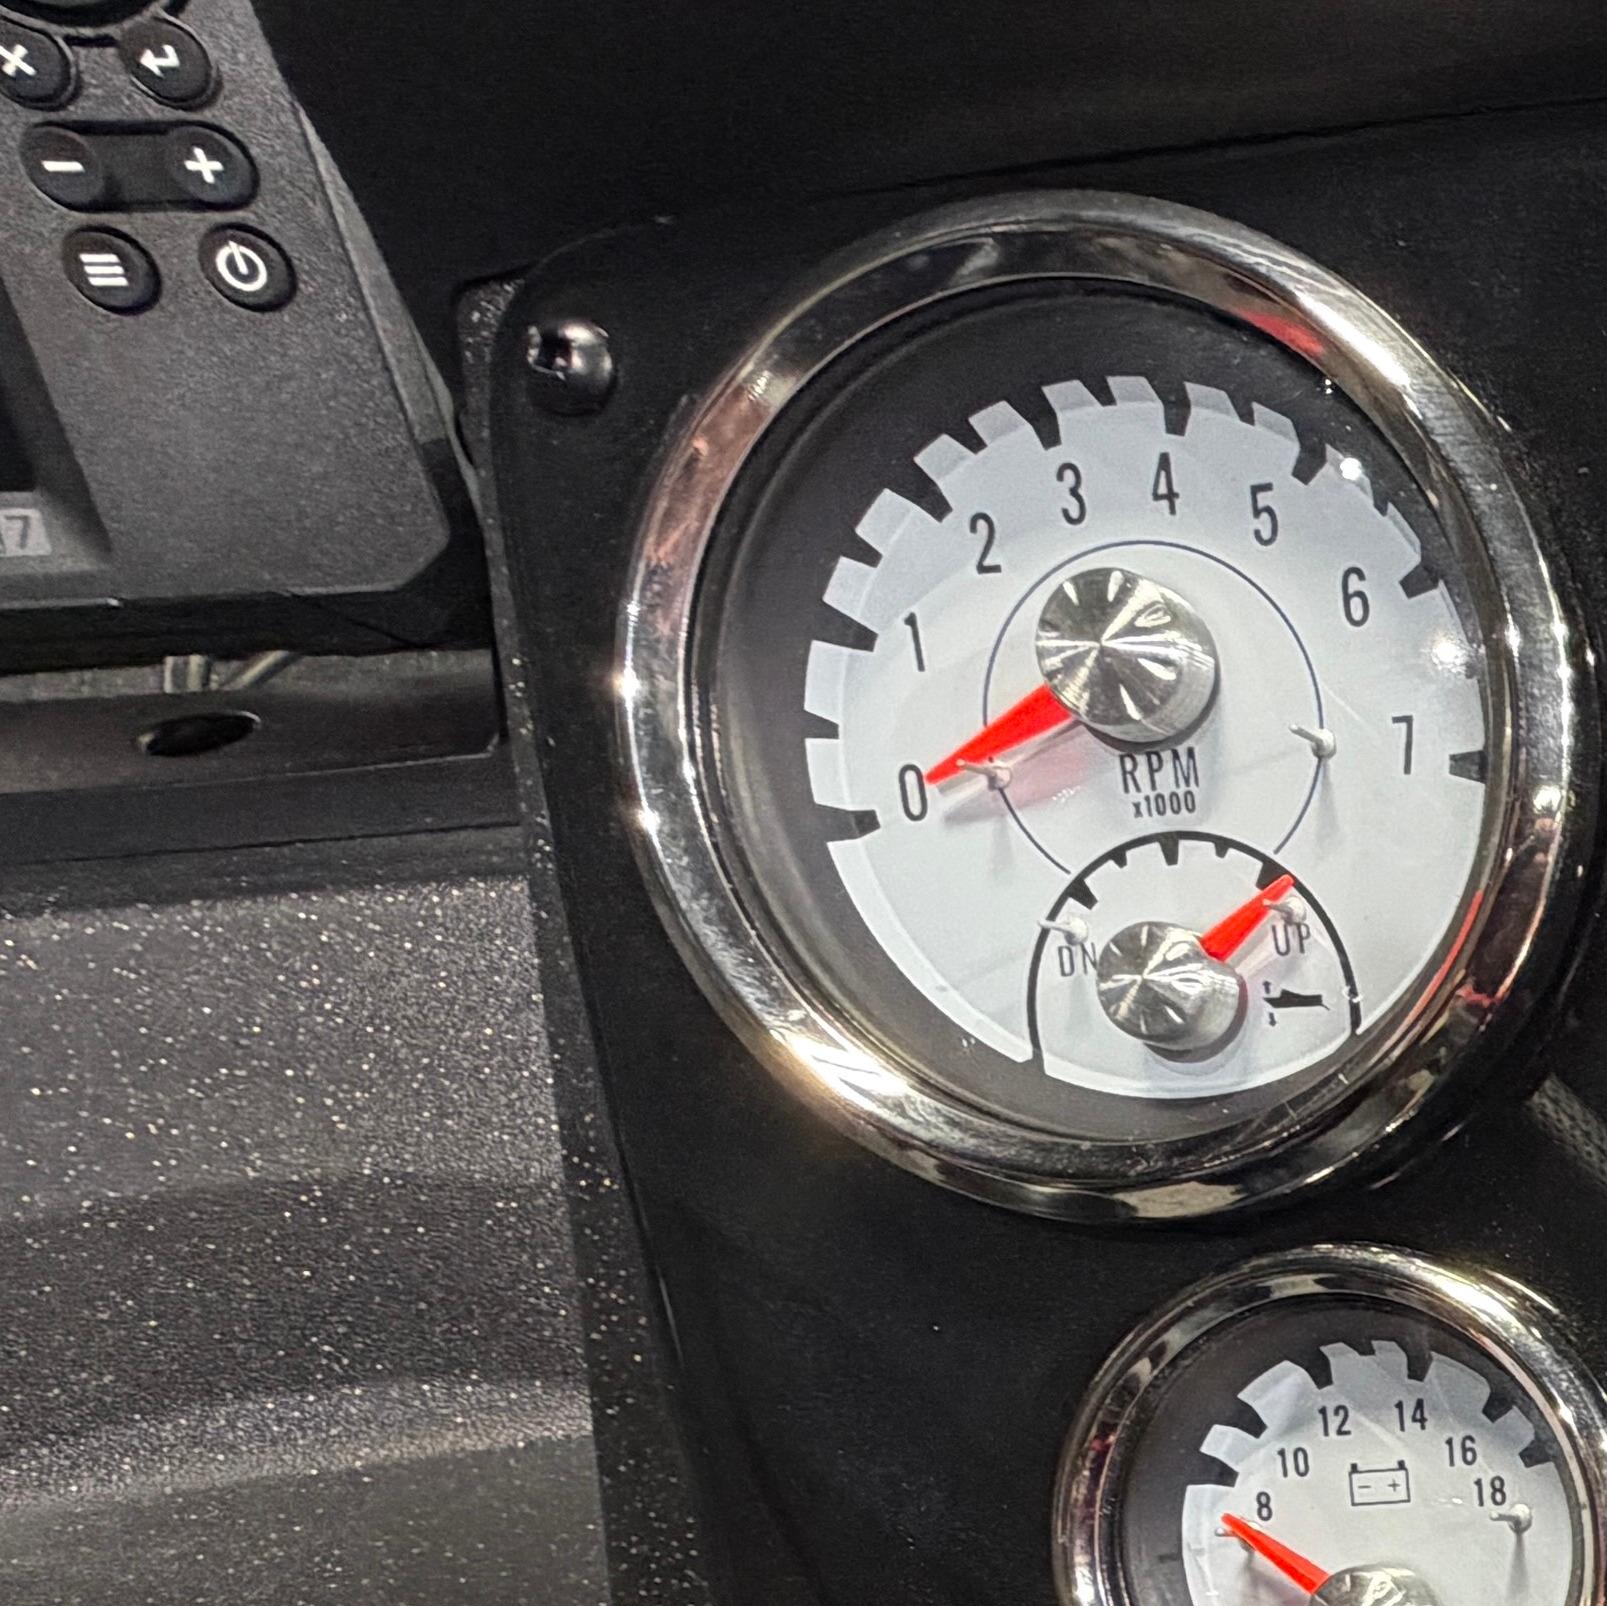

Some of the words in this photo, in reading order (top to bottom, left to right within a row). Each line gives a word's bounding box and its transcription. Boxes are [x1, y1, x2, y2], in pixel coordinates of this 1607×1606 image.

[1057, 463, 1085, 525] 3
[1152, 453, 1179, 515] 4
[1250, 483, 1278, 545] 5
[970, 512, 1001, 574] 2
[1342, 567, 1369, 626] 6
[904, 613, 924, 671] 1
[1392, 716, 1413, 774] 7
[899, 764, 927, 821] 0
[1120, 747, 1200, 795] RPM
[1133, 790, 1195, 817] x1000
[1269, 918, 1312, 958] UP
[1318, 1405, 1351, 1436] 12
[1395, 1398, 1427, 1431] 14
[1278, 1447, 1309, 1477] 10
[1446, 1435, 1477, 1466] 16
[1256, 1492, 1272, 1521] 8
[1474, 1476, 1506, 1506] 18
